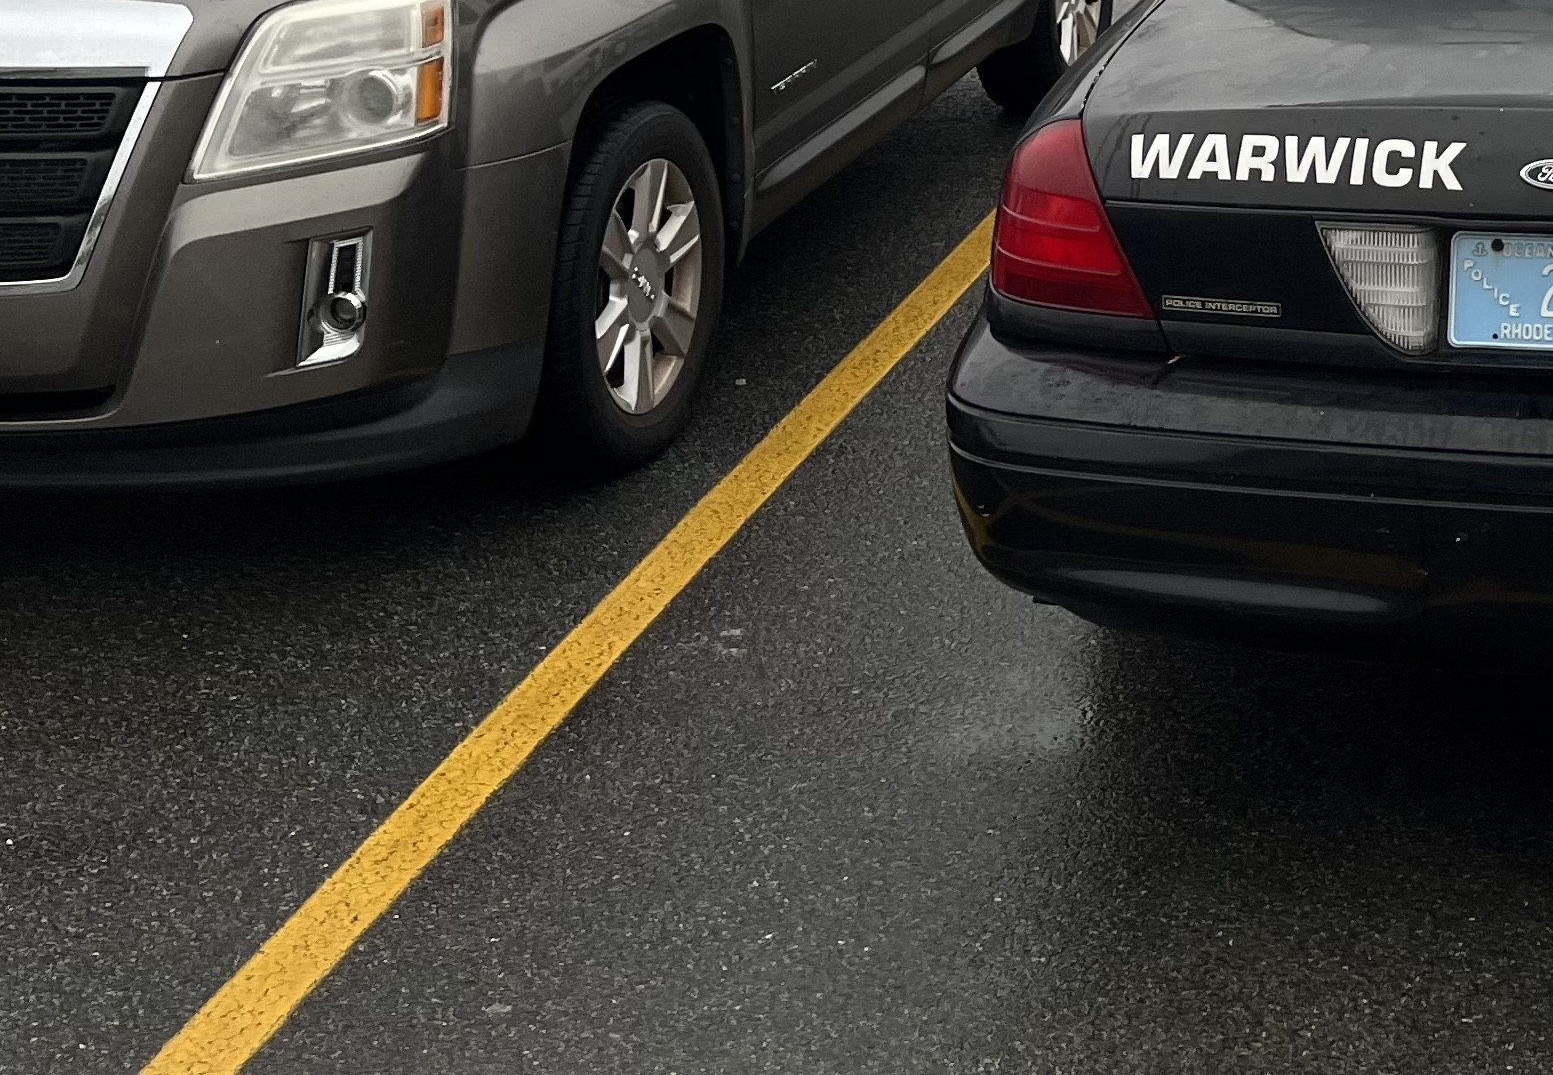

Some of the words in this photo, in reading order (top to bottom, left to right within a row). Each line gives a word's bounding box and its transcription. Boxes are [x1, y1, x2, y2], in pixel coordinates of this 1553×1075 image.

[1130, 133, 1468, 192] WARWICK
[1165, 299, 1203, 309] POLICE
[1204, 302, 1278, 314] INTERCEPTOR
[1463, 259, 1521, 317] POLICE
[1500, 323, 1553, 341] RHODE
